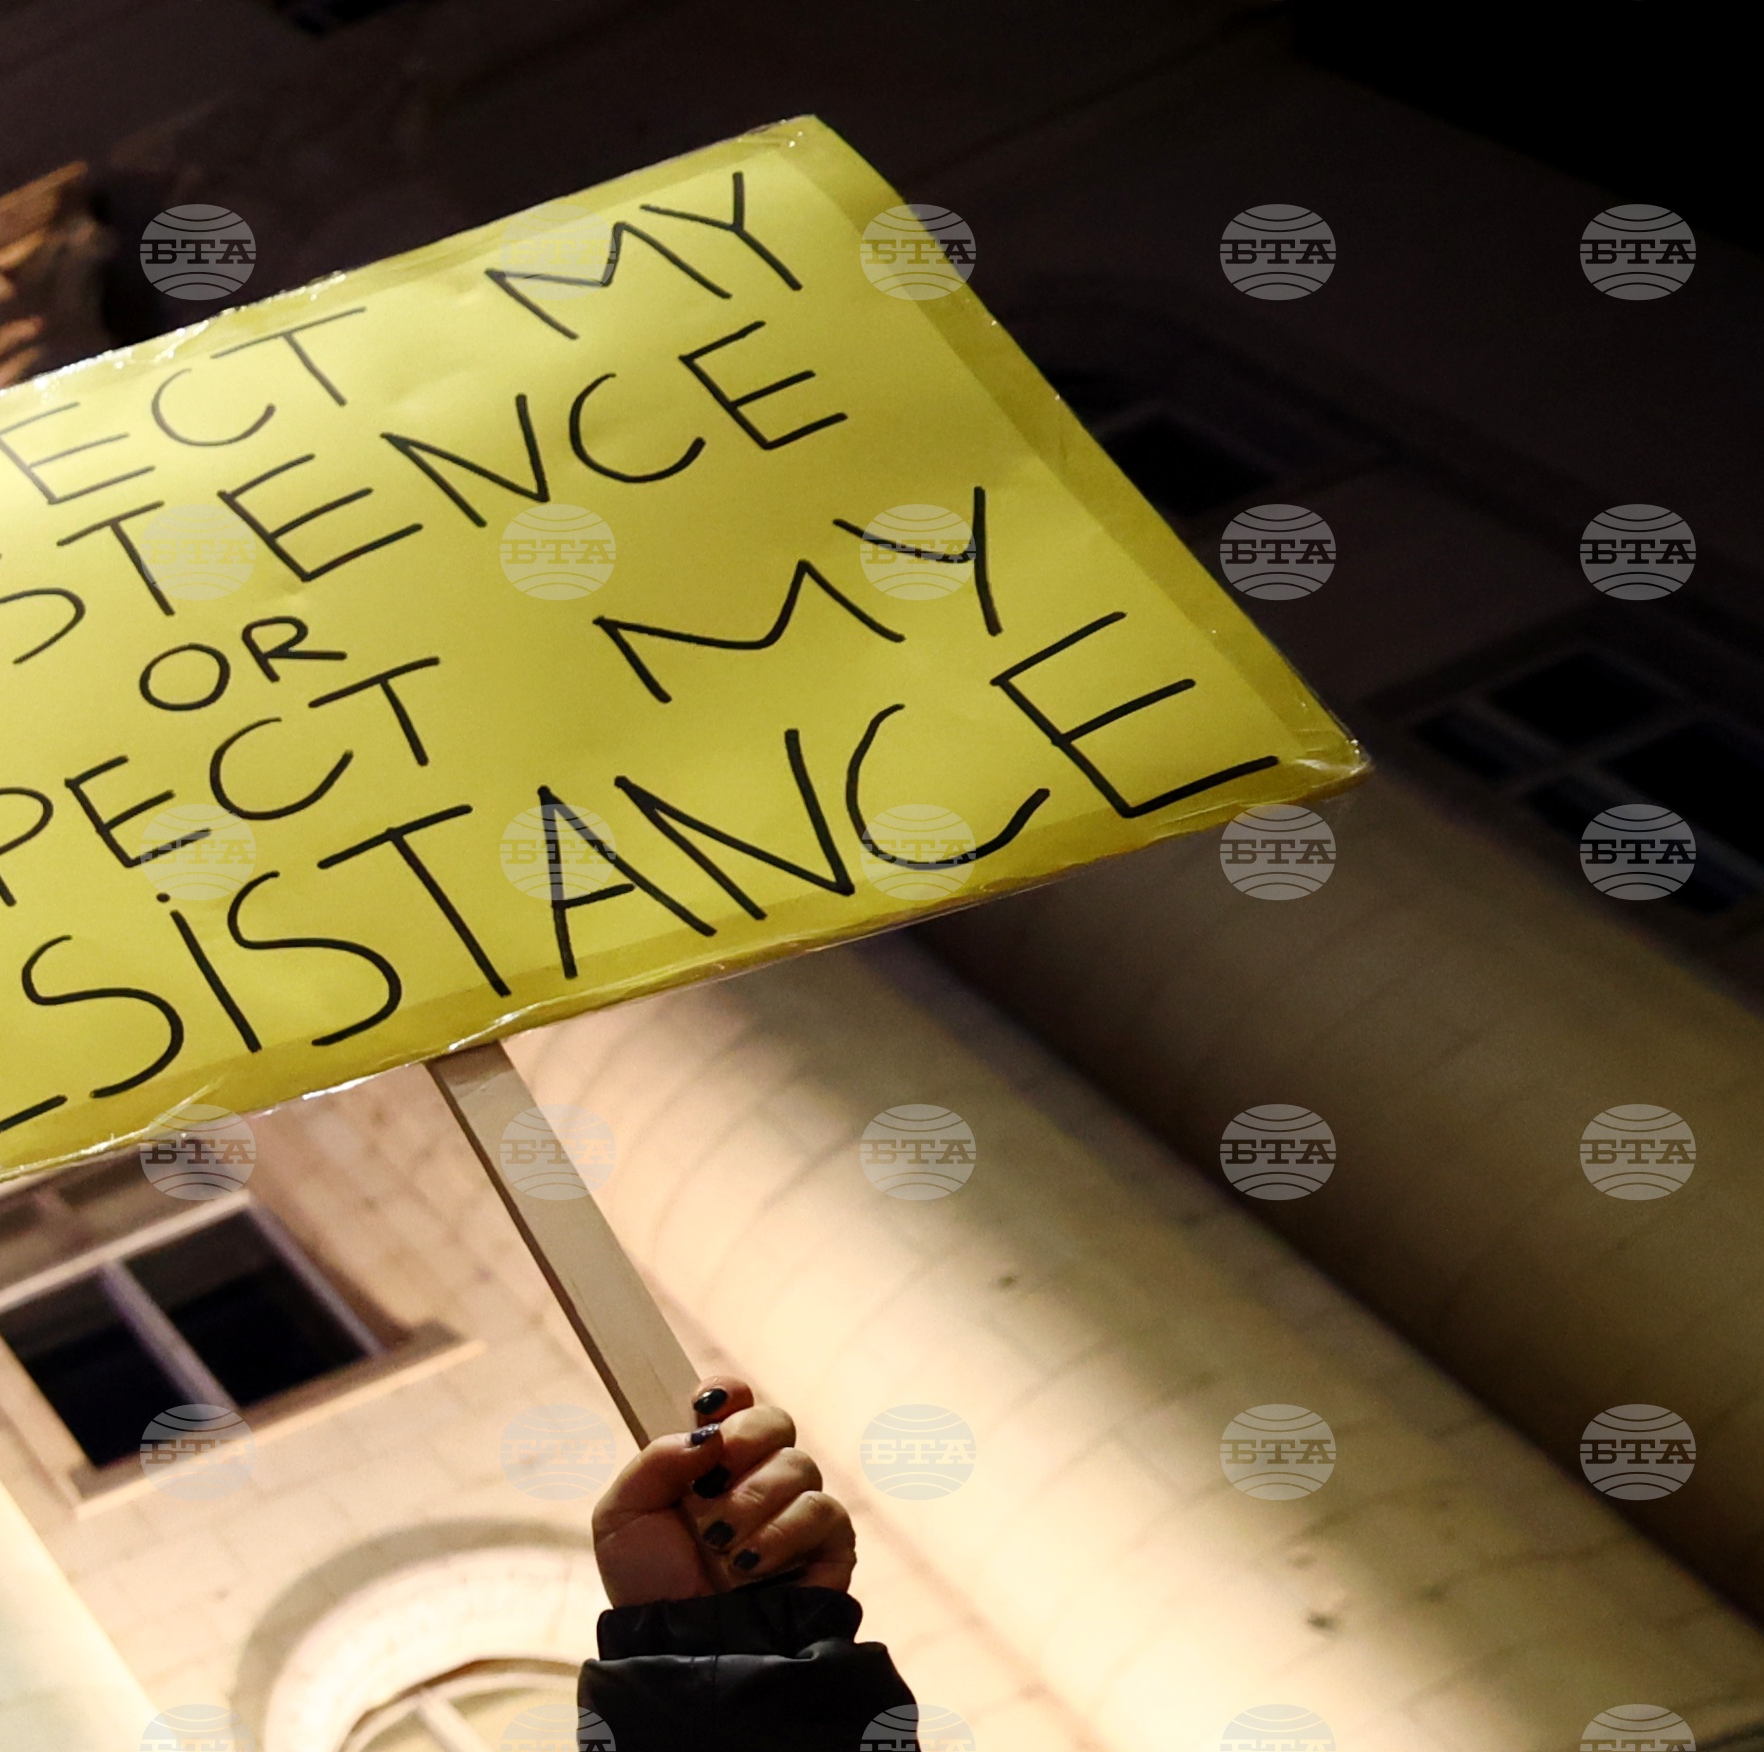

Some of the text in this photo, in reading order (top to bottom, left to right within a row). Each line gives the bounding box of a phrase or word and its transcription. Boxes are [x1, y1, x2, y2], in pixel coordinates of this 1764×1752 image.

[487, 170, 801, 340] MY
[140, 615, 346, 712] OR
[596, 487, 1001, 703] MY
